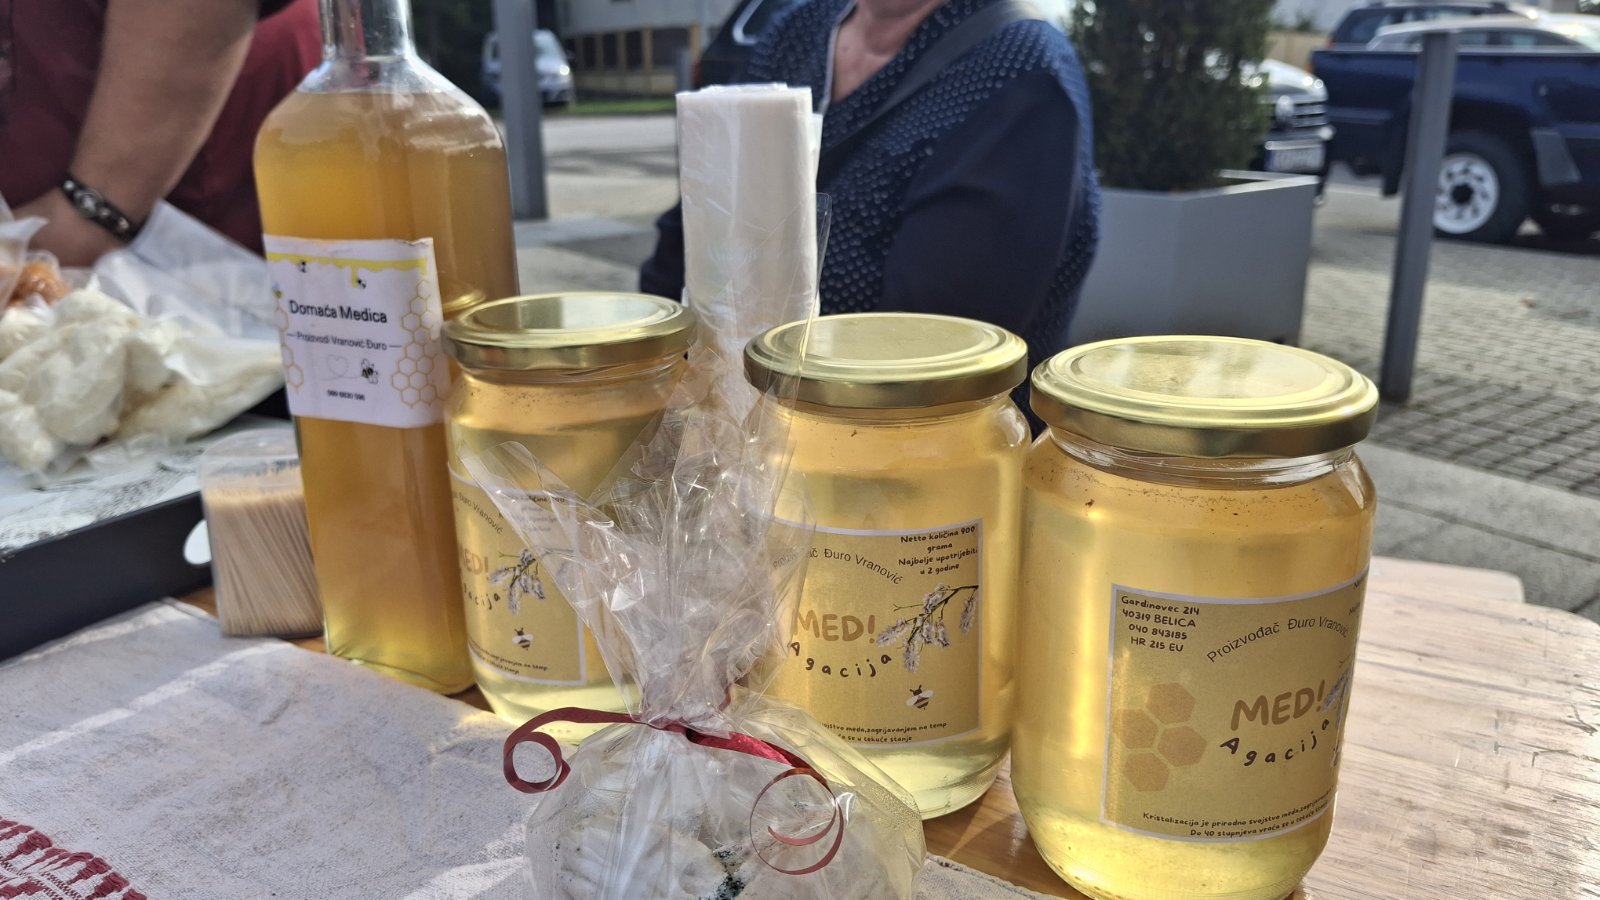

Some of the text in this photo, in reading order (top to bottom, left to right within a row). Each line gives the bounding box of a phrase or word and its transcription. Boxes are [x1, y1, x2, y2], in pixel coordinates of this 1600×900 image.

[290, 300, 388, 323] Domaća Medica
[900, 526, 976, 543] Netto količina 900
[898, 546, 978, 567] Najbolje upotrijebiti
[927, 543, 953, 554] grama
[824, 548, 852, 562] Đuro
[855, 553, 903, 585] Vranović
[927, 567, 933, 575] 2
[935, 563, 960, 575] godine
[1121, 595, 1200, 616] Gardinovec 214
[791, 608, 876, 644] MED!
[1122, 608, 1197, 628] 40319 BELICA
[1128, 623, 1188, 640] 040 843185
[1206, 622, 1280, 664] Proizvođač
[1287, 617, 1316, 630] Đuro
[1130, 636, 1184, 652] HR 215 EU
[788, 641, 892, 678] Agacija
[1231, 680, 1325, 731] MED!
[889, 735, 913, 743] stanje
[1219, 719, 1330, 767] Agacija
[1143, 812, 1199, 827] Kristalizacija
[1200, 819, 1210, 828] je
[1211, 819, 1247, 829] prirodno
[1190, 829, 1202, 837] Do
[1217, 828, 1257, 838] stupnjeva
[1259, 822, 1280, 833] vraća
[1282, 821, 1289, 829] se
